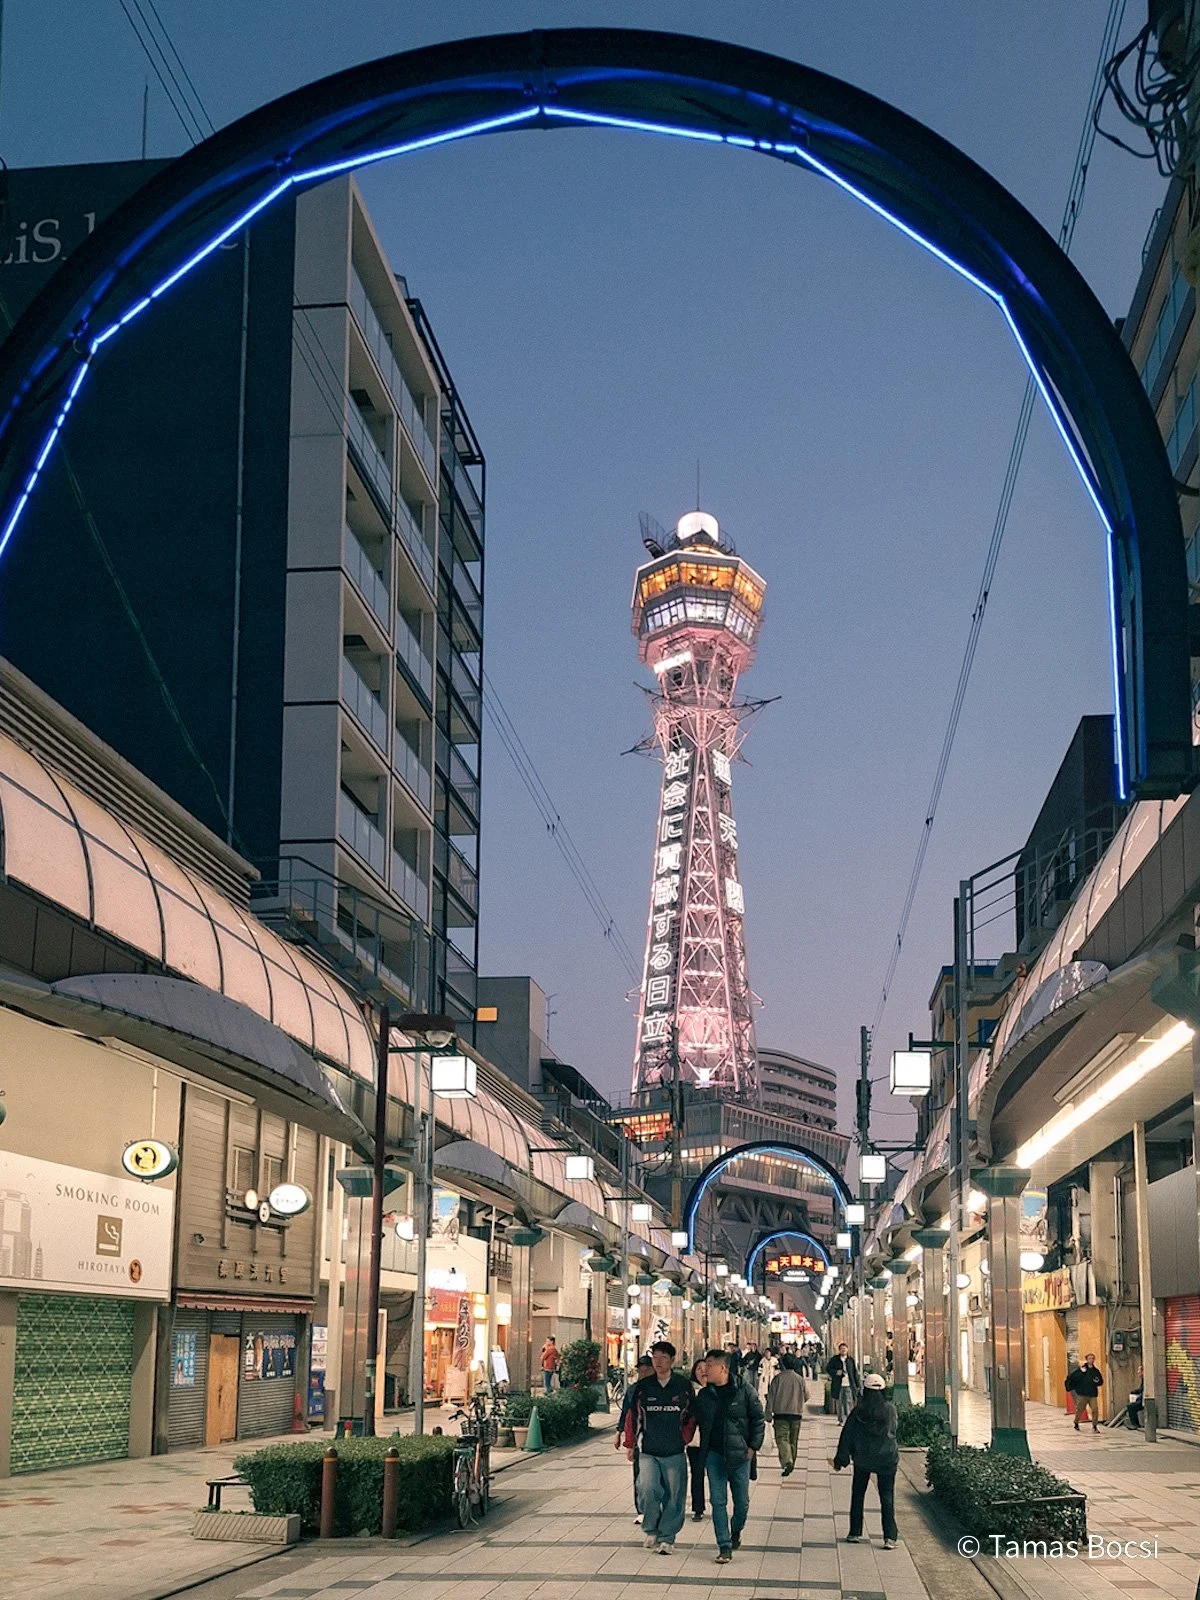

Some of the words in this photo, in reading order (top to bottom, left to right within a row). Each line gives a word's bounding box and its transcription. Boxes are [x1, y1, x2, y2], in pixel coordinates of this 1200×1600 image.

[642, 747, 693, 1042] 社会に貢献する日立
[55, 1183, 119, 1208] SMOKING
[124, 1198, 160, 1216] ROOM
[78, 1260, 126, 1275] HIROTAYA
